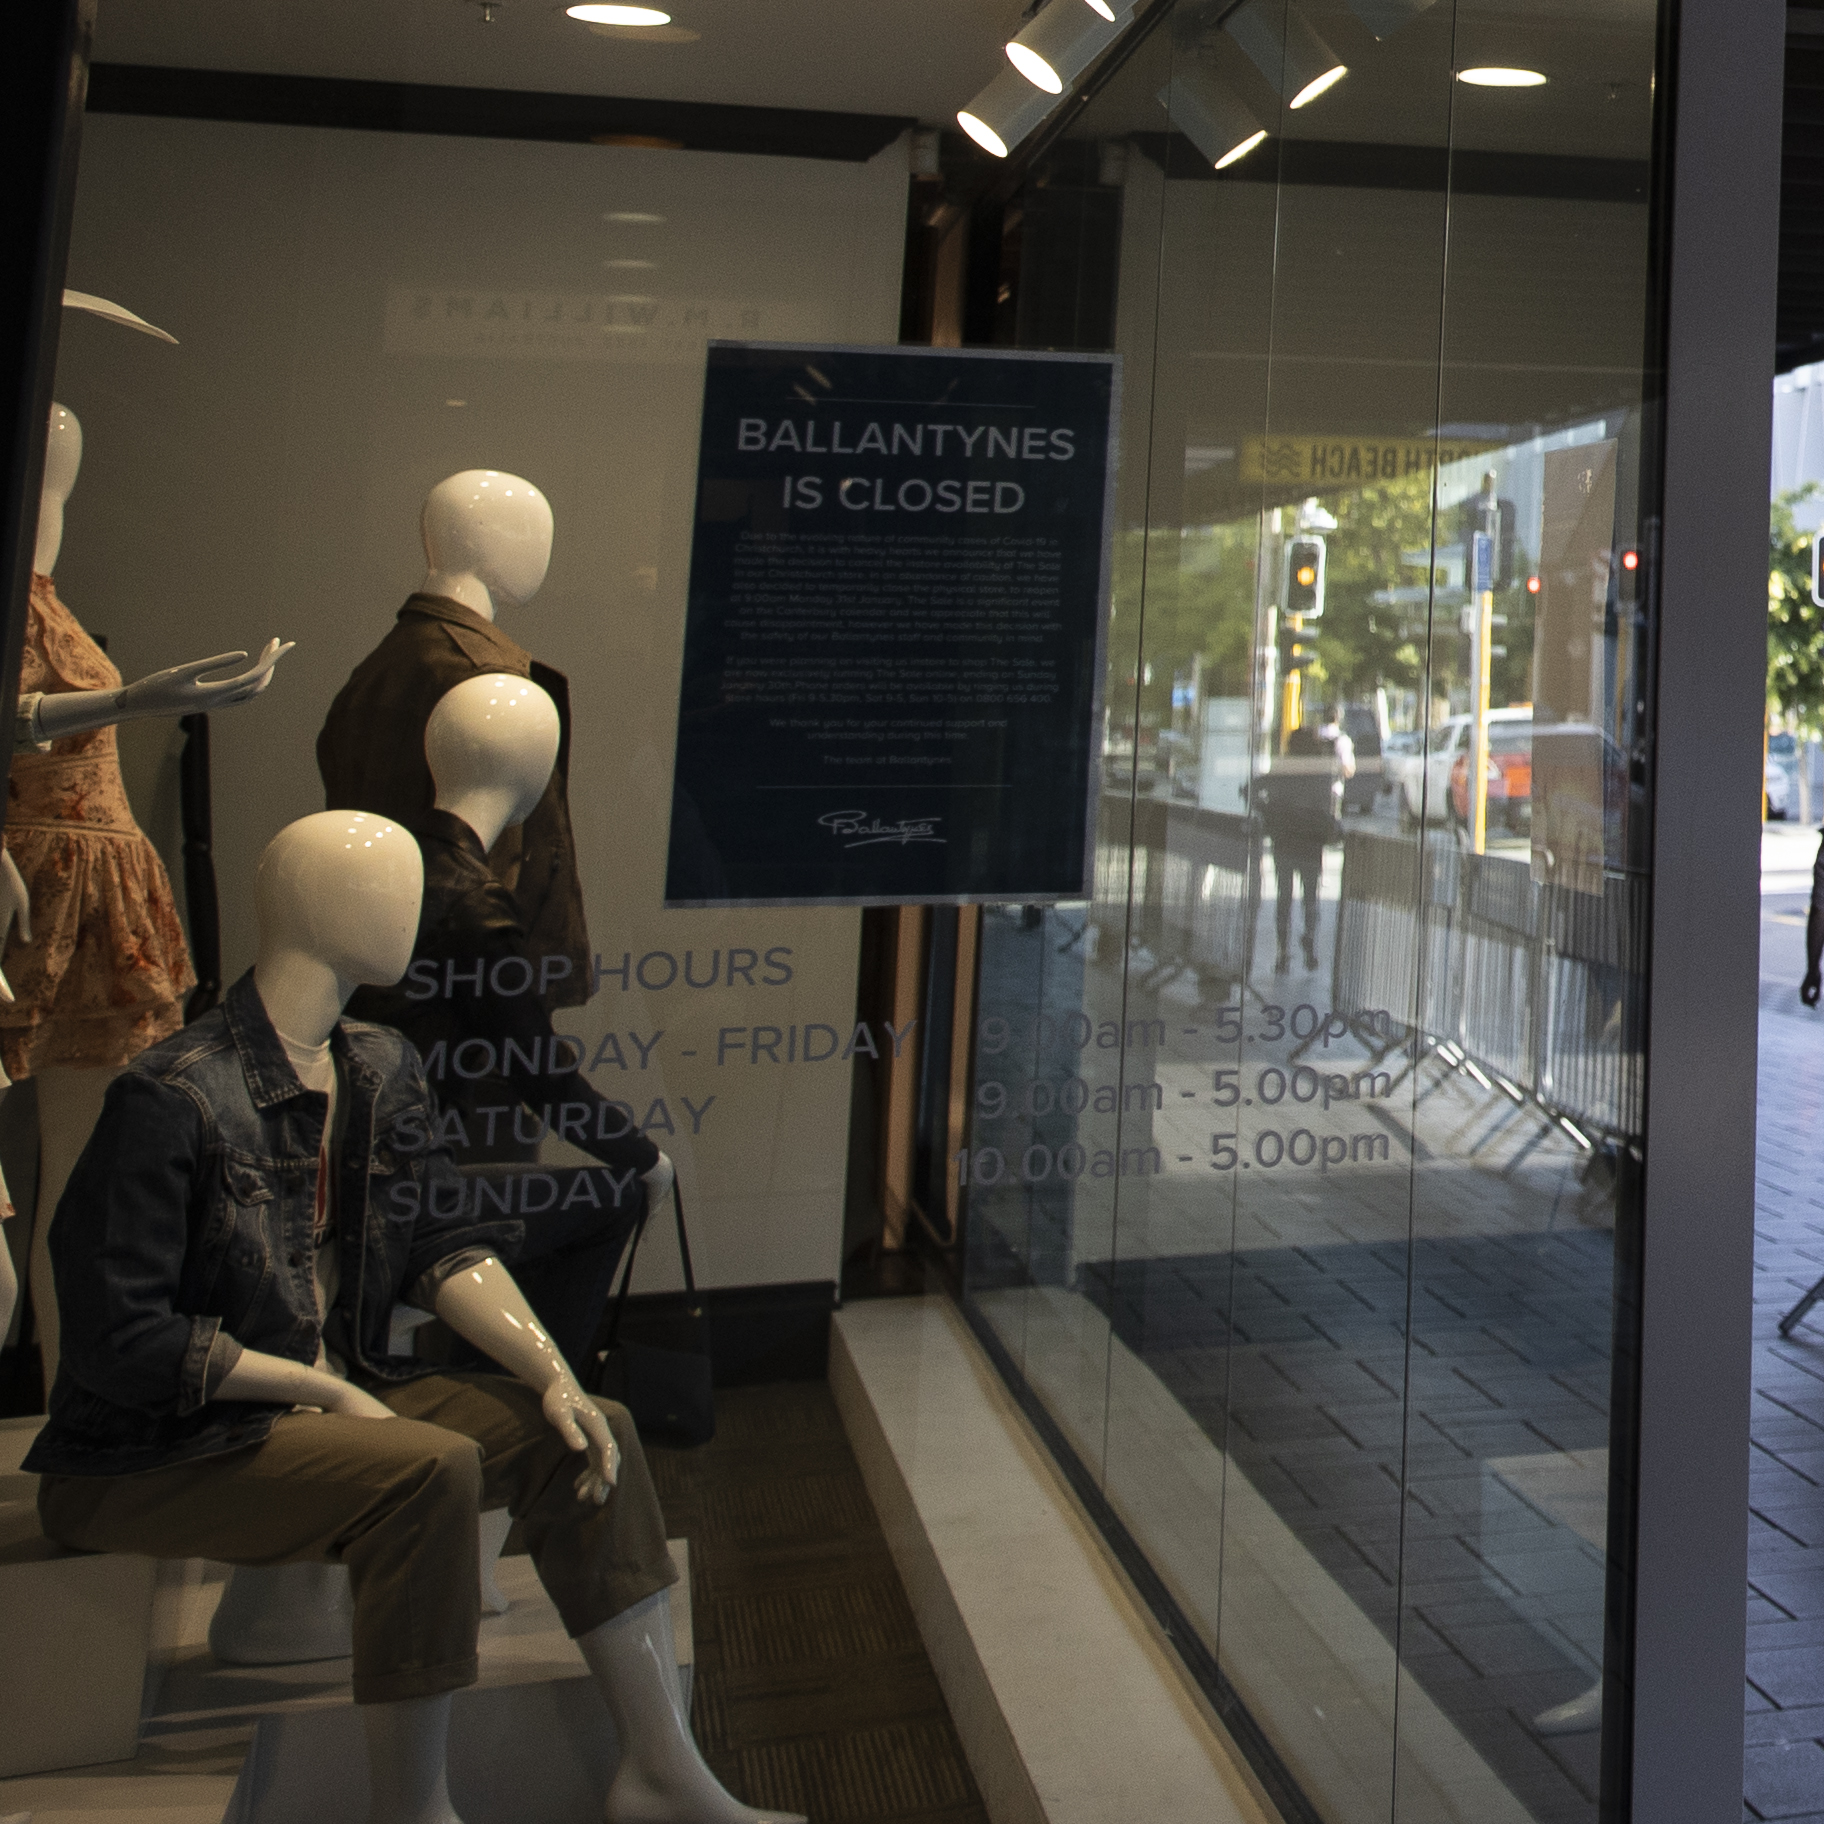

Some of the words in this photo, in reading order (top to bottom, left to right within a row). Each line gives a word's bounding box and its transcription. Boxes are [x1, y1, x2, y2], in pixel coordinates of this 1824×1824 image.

[738, 418, 1075, 461] BALLANTYNES
[782, 476, 823, 509] IS
[839, 477, 1025, 513] CLOSED
[405, 954, 573, 1001] SHOP
[592, 947, 794, 993] HOURS
[400, 1029, 664, 1083] MONDAY
[716, 1019, 918, 1066] FRIDAY
[1214, 1003, 1391, 1050] 5.30pm
[391, 1095, 717, 1153] SATURDAY
[1212, 1065, 1393, 1110] 5.00pm
[387, 1167, 638, 1223] SUNDAY
[953, 1141, 1162, 1187] 10.00am
[1210, 1127, 1389, 1172] 5.00pm
